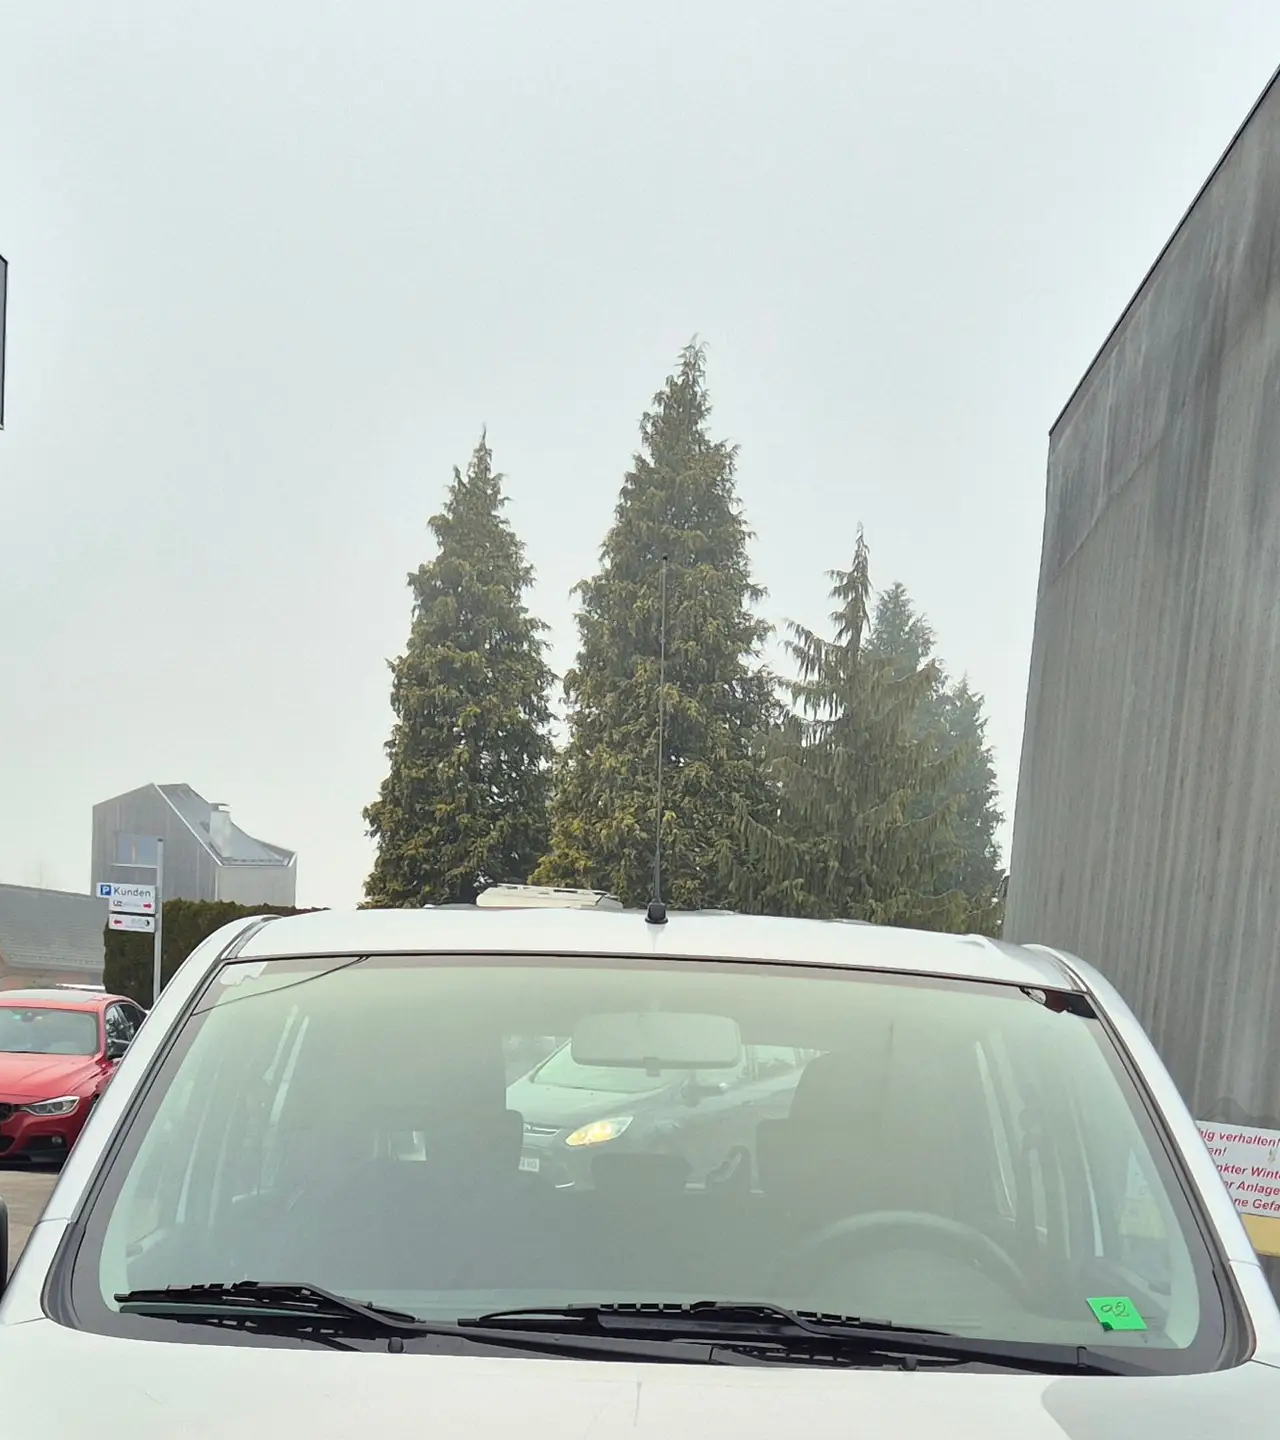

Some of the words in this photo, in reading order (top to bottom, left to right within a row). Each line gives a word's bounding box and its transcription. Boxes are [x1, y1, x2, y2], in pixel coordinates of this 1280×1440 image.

[114, 887, 151, 897] Kunden
[1199, 1128, 1216, 1142] ig
[1219, 1132, 1280, 1147] verhalten!
[1208, 1147, 1227, 1157] en!
[1216, 1163, 1248, 1175] nkter
[1223, 1181, 1236, 1189] er
[1234, 1198, 1249, 1207] ne
